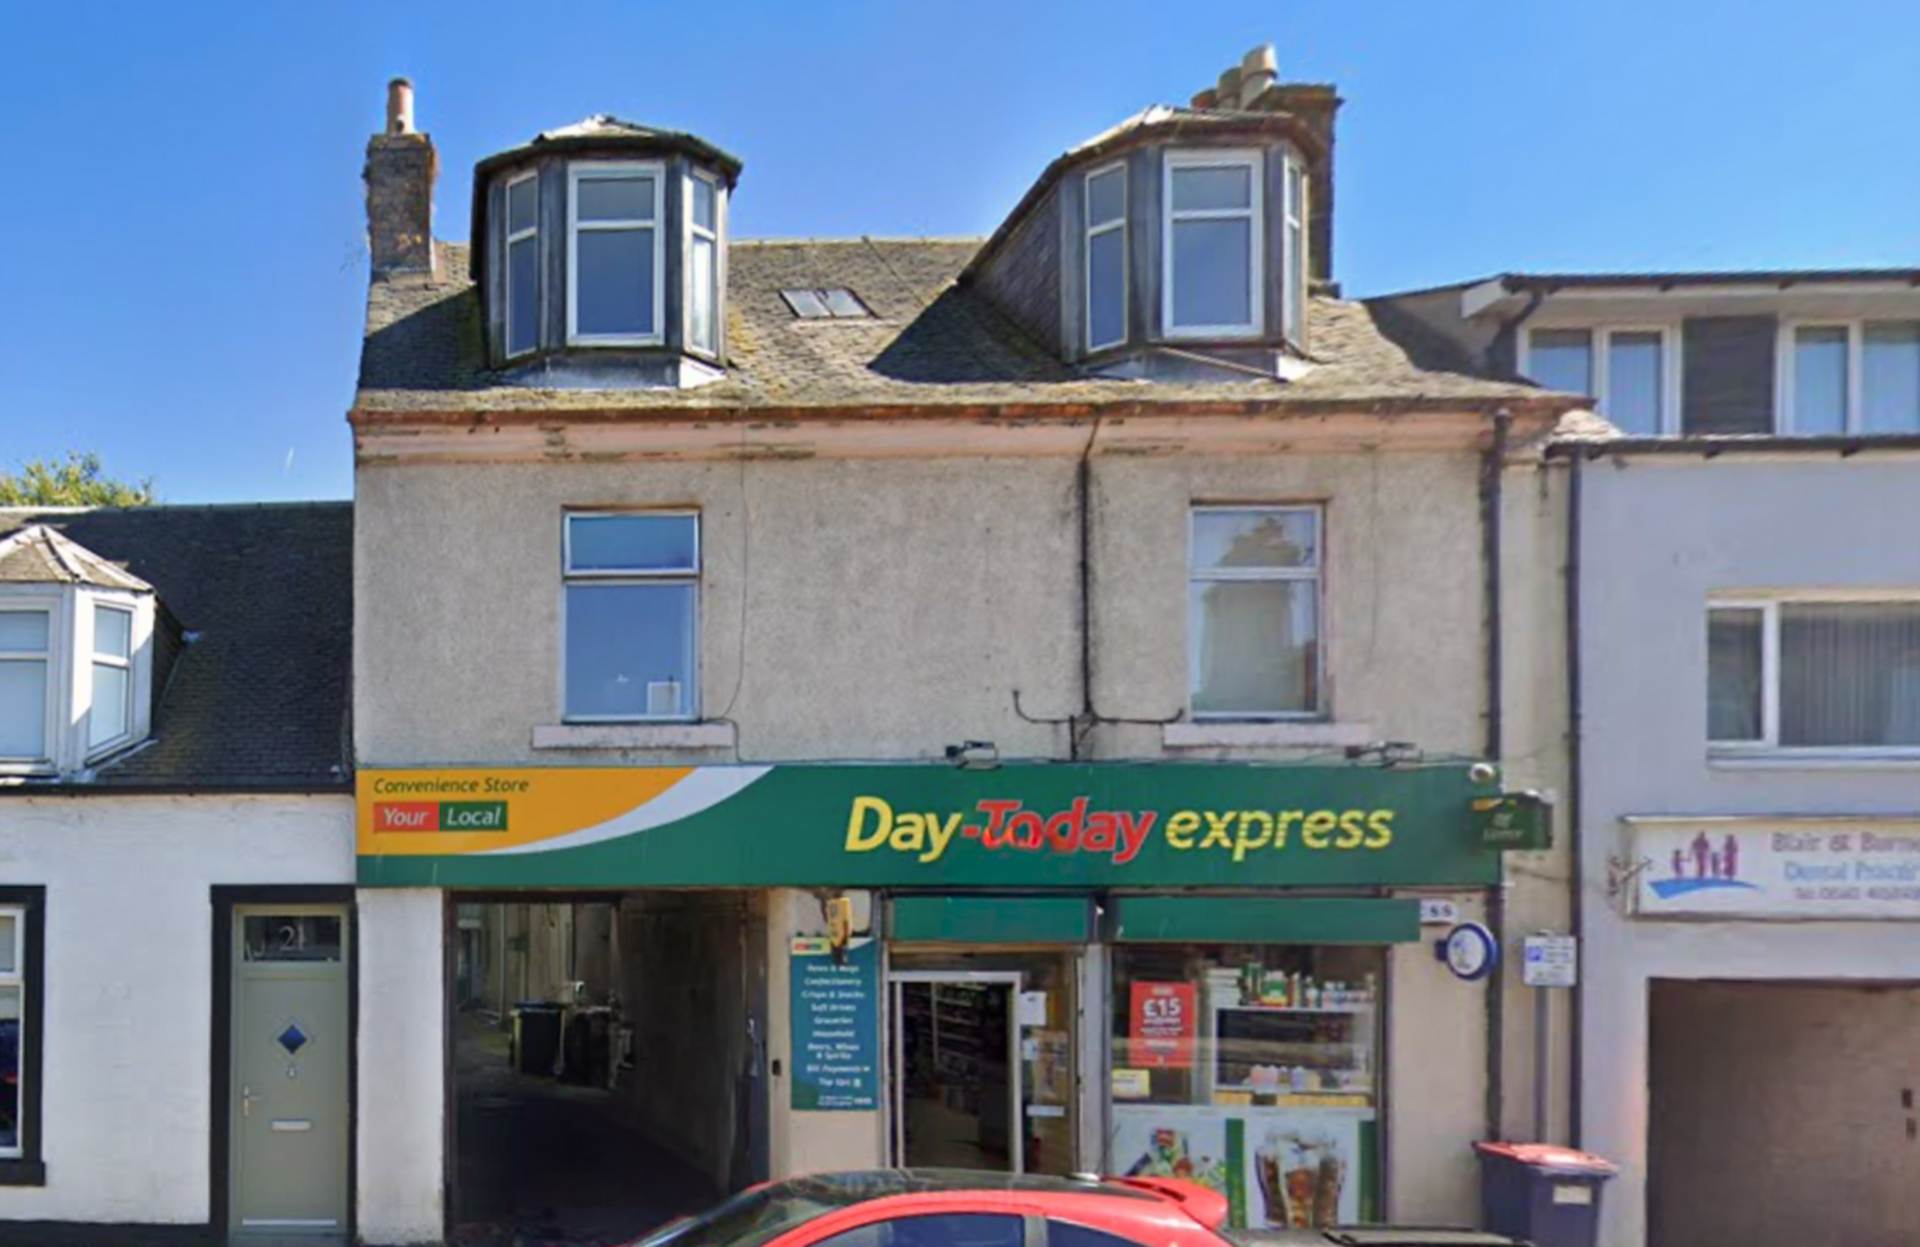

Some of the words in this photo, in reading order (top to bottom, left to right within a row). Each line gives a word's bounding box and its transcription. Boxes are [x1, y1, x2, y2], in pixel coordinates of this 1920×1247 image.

[373, 778, 479, 794] Convenience
[483, 776, 529, 793] Store
[383, 808, 428, 826] Your
[446, 806, 501, 826] Local
[1165, 810, 1395, 862] express
[279, 924, 306, 951] 21
